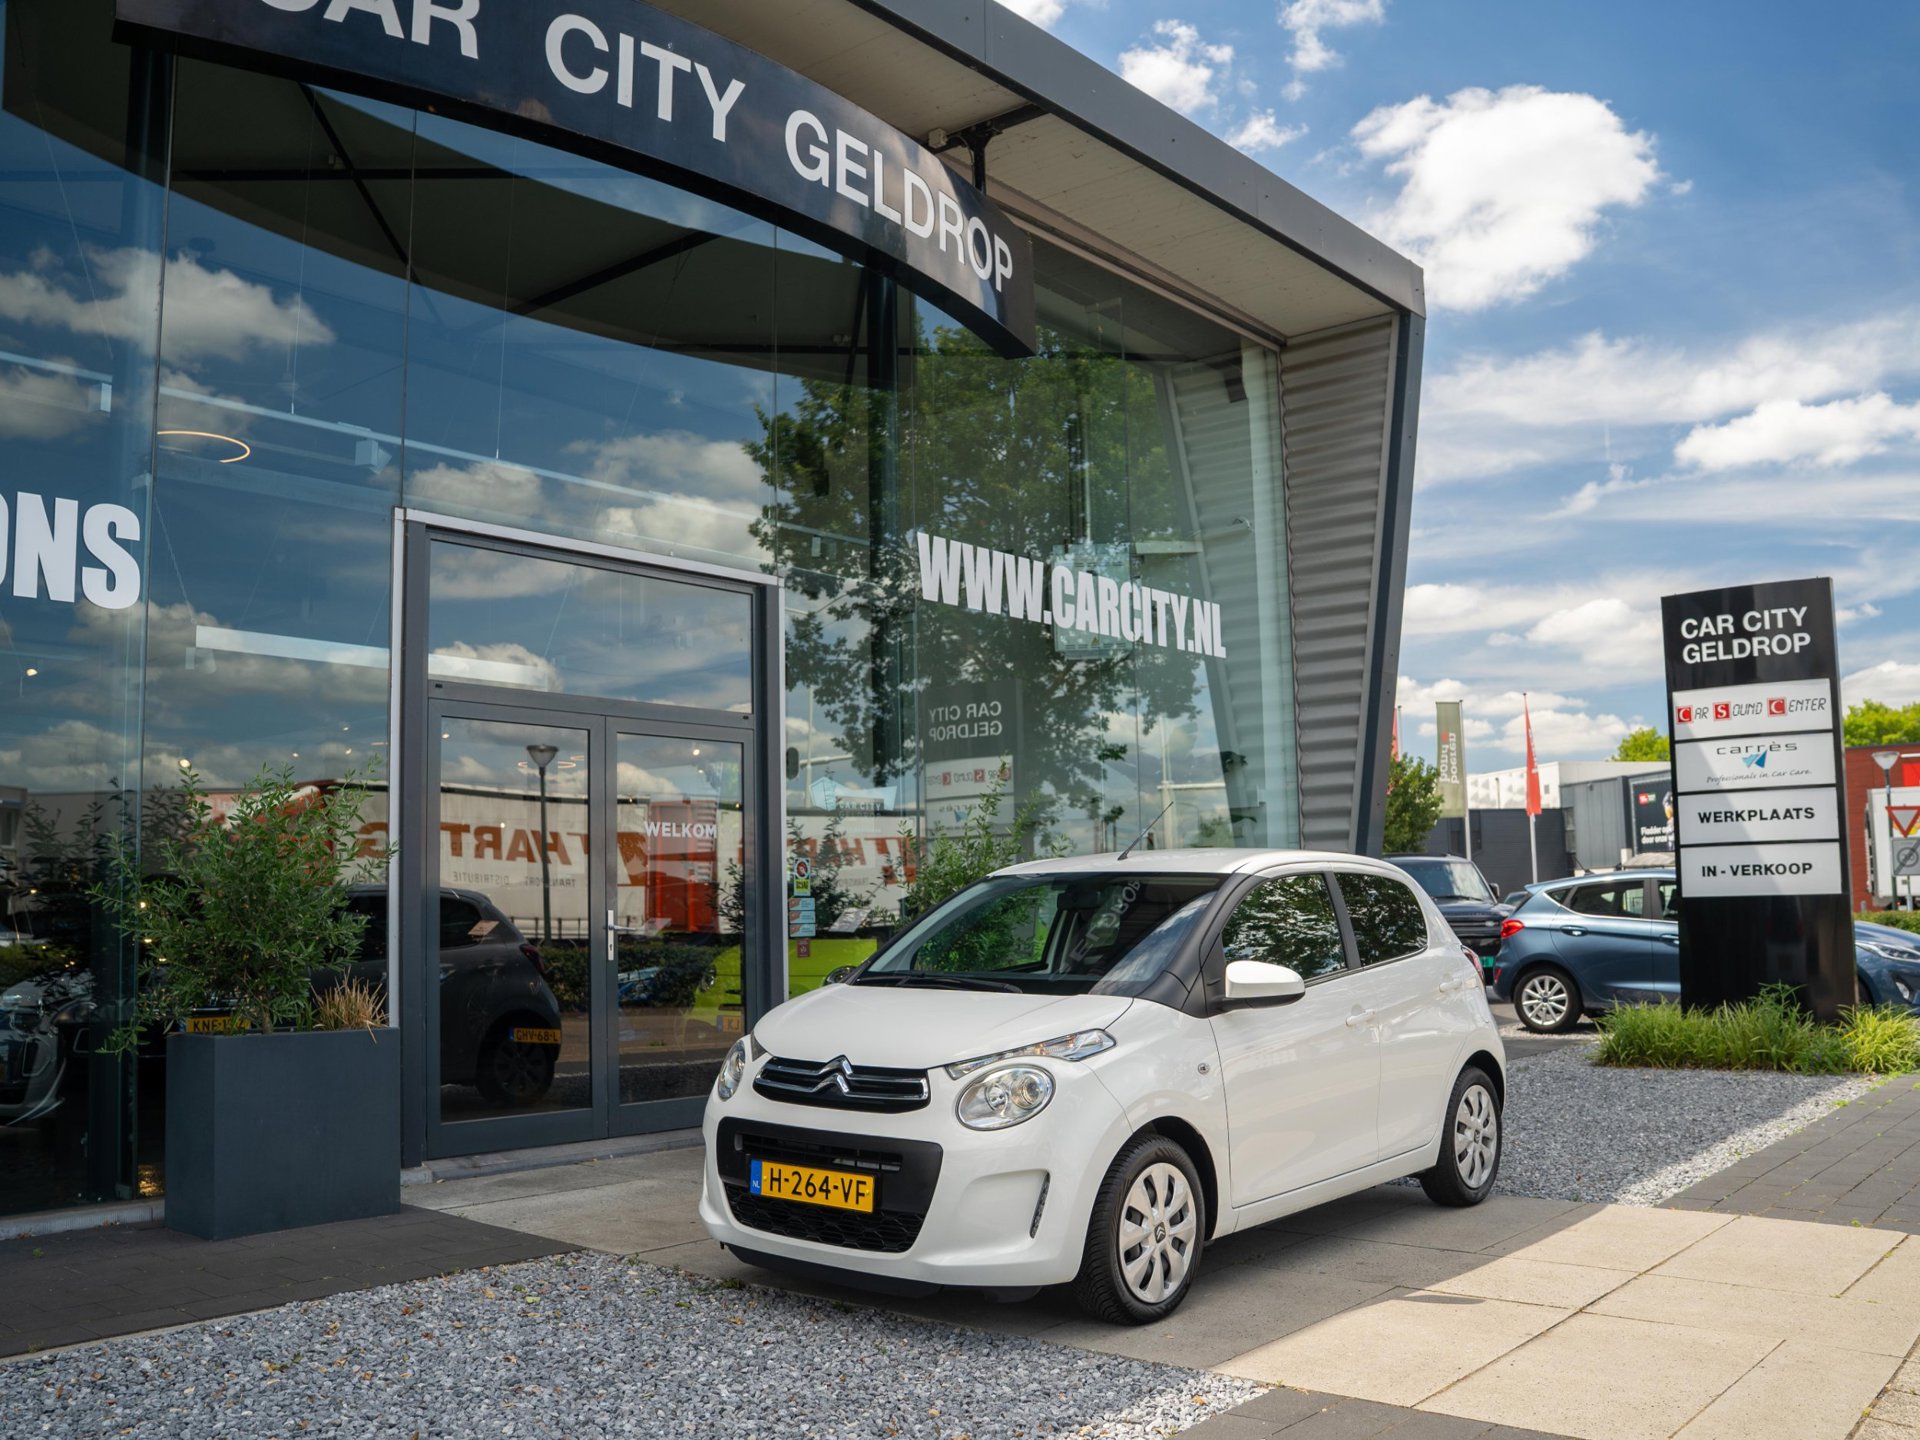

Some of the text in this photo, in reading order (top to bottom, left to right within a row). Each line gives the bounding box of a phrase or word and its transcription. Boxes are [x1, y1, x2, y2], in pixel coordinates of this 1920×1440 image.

[545, 14, 746, 142] CITY
[785, 109, 1013, 292] GELDROP
[0, 492, 141, 609] NS
[917, 532, 1226, 659] WWW.CARCITY.NL
[1681, 606, 1807, 639] CAR CITY
[1682, 632, 1811, 664] GELDROP
[1716, 741, 1798, 756] carrès
[644, 821, 717, 838] WELKOM
[1698, 807, 1815, 824] WERKPLAATS
[1730, 862, 1813, 876] VERKOOP
[752, 1167, 867, 1205] NL H-264-VF
